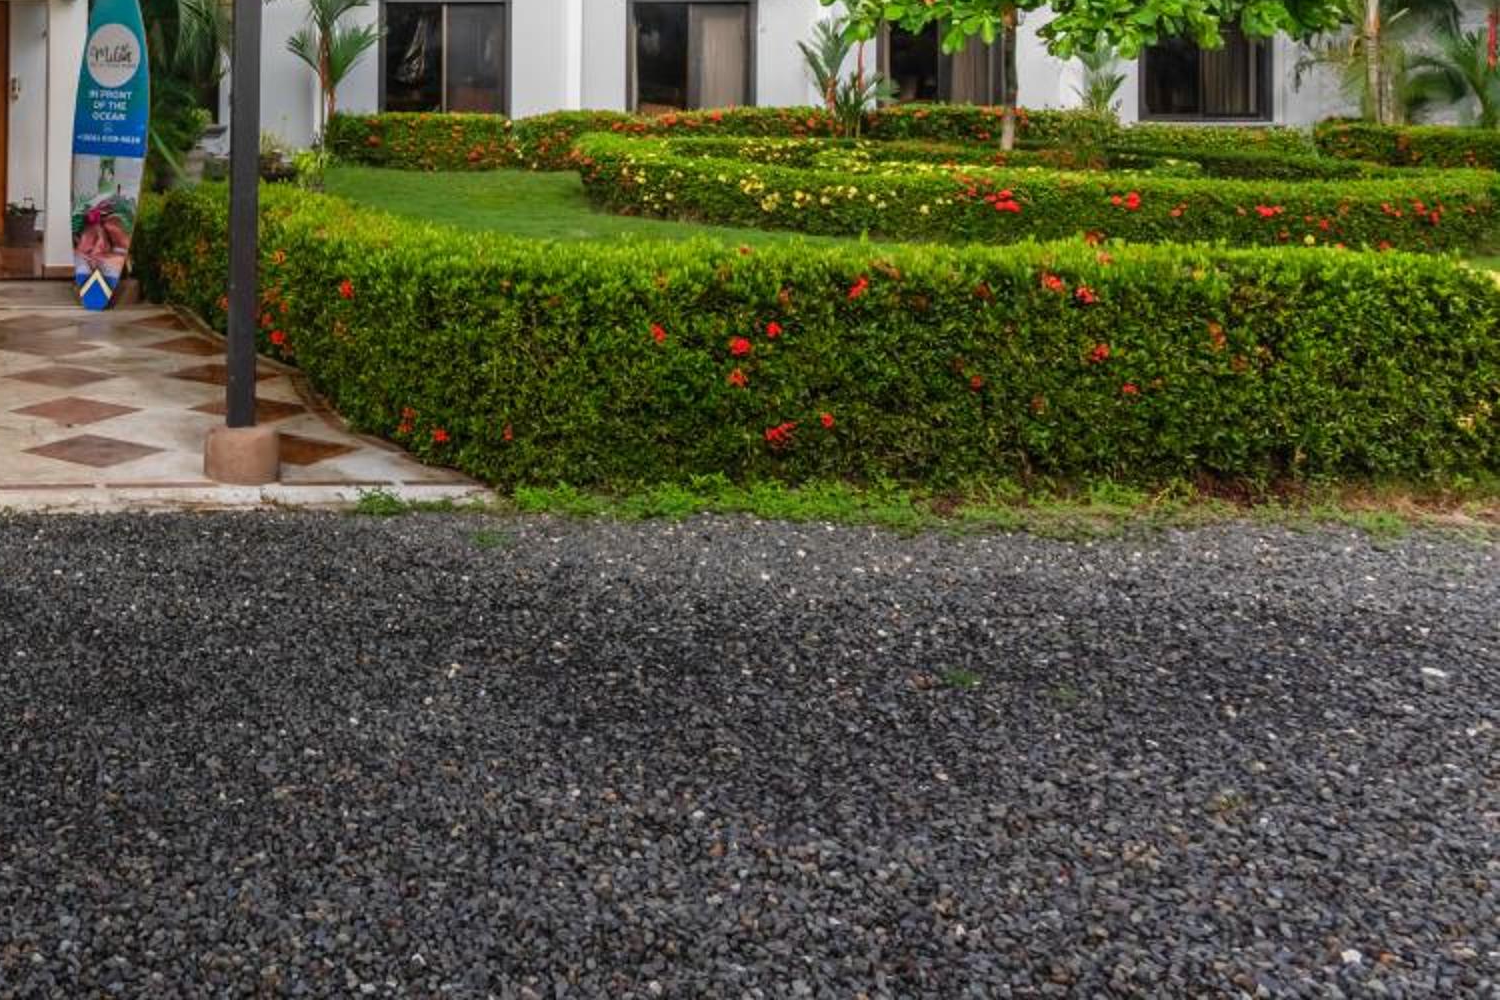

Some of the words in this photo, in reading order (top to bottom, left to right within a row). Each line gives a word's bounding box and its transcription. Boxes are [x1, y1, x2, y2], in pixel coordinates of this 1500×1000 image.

[100, 89, 132, 100] FRONT
[93, 100, 106, 110] OF
[108, 101, 127, 111] THE
[91, 111, 126, 121] OCEAN
